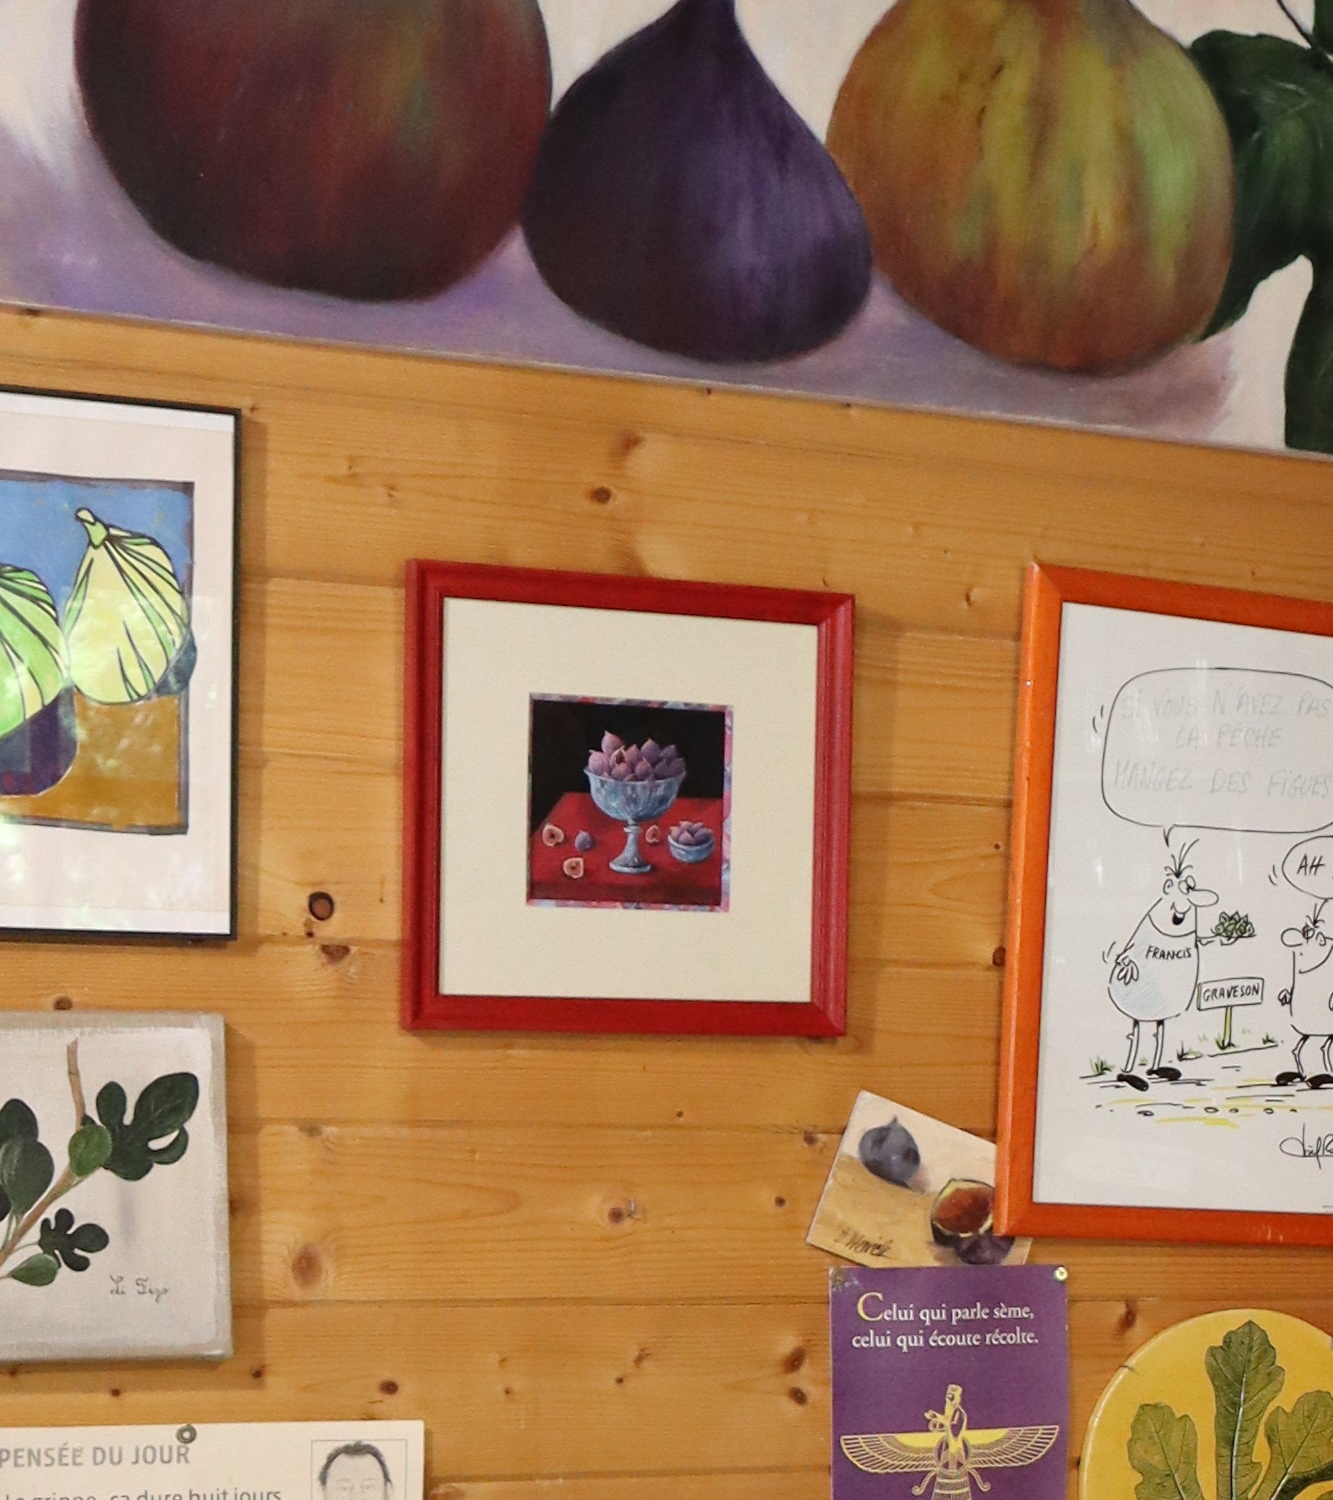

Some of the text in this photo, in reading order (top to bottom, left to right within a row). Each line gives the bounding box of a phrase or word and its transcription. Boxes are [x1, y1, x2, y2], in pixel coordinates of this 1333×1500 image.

[1297, 854, 1325, 876] AH
[1146, 946, 1192, 960] FRANCIS
[1203, 982, 1260, 1002] GRAVESON
[857, 1292, 1035, 1326] Celui qui parle sème,
[852, 1326, 1039, 1352] celui qui écoute récolte.
[92, 1447, 123, 1466] DU
[131, 1444, 190, 1465] JOUR
